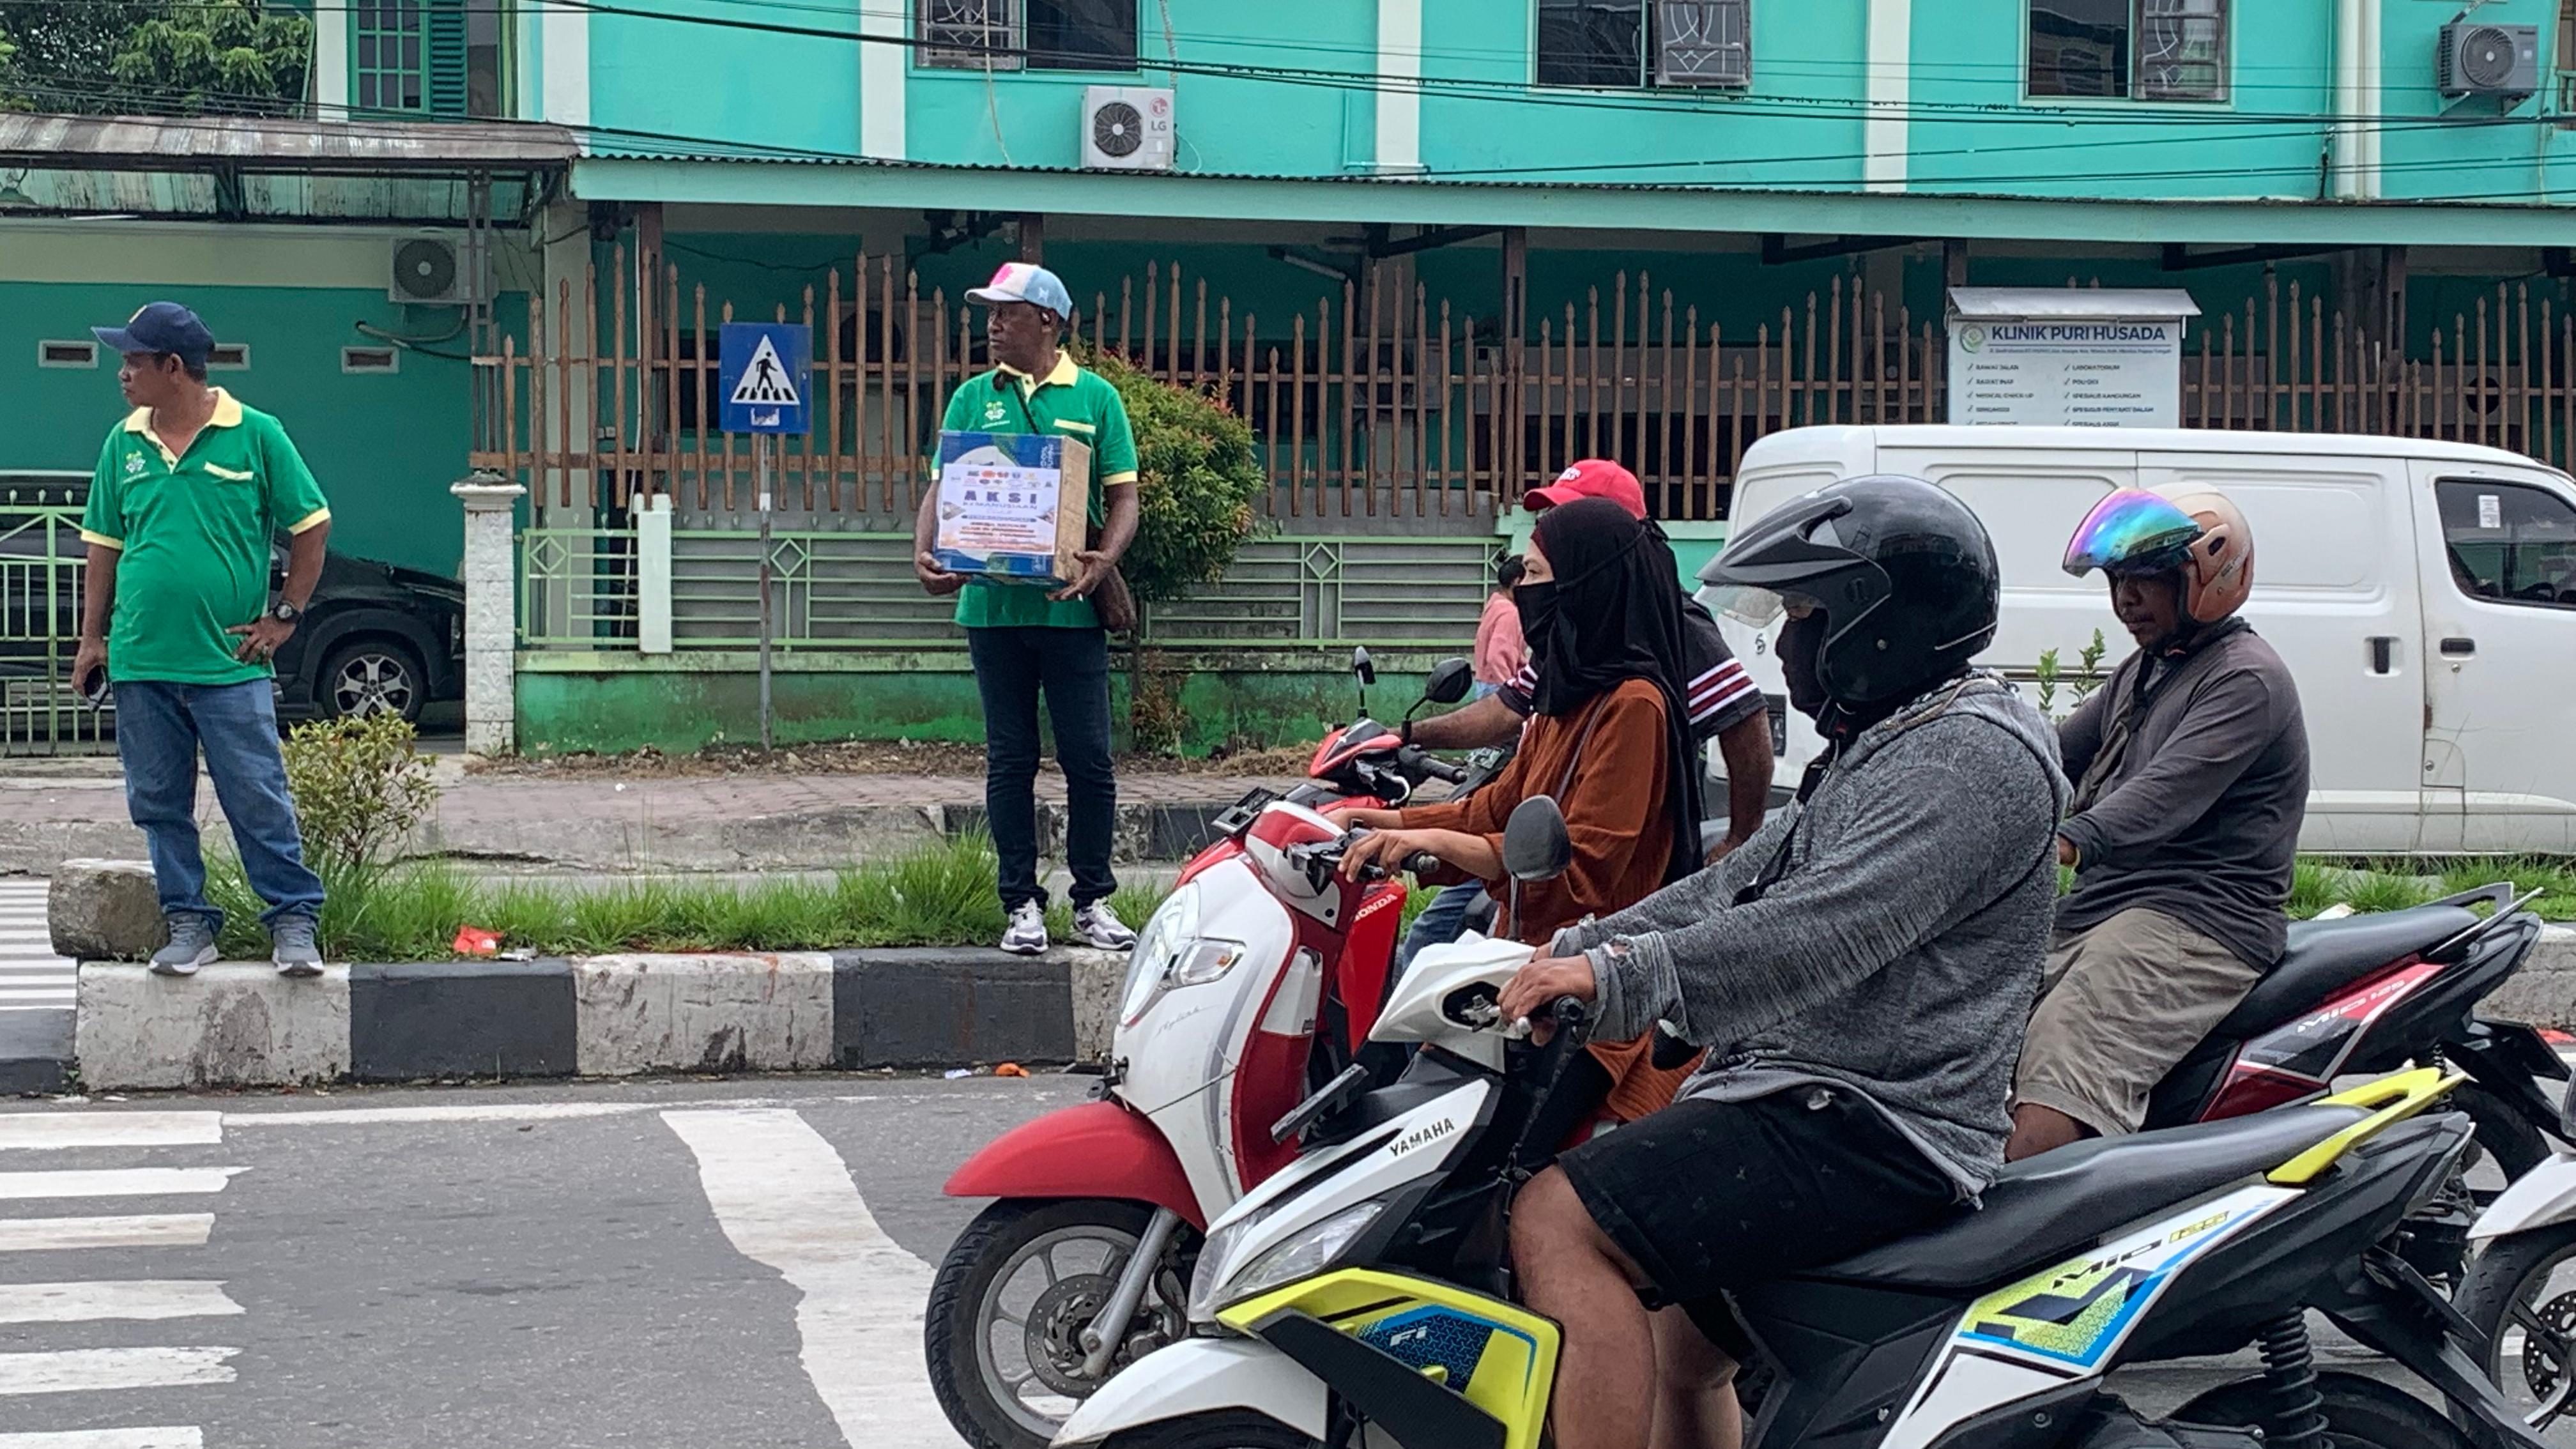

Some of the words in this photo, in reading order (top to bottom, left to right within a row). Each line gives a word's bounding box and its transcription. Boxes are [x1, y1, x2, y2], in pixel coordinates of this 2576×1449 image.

[1151, 120, 1167, 132] LG
[1991, 326, 2046, 341] KLINIK
[2051, 326, 2090, 341] PURI
[2094, 326, 2166, 341] HUSADA
[964, 490, 1038, 505] AKSI
[1390, 1117, 1455, 1157] YAMAHA
